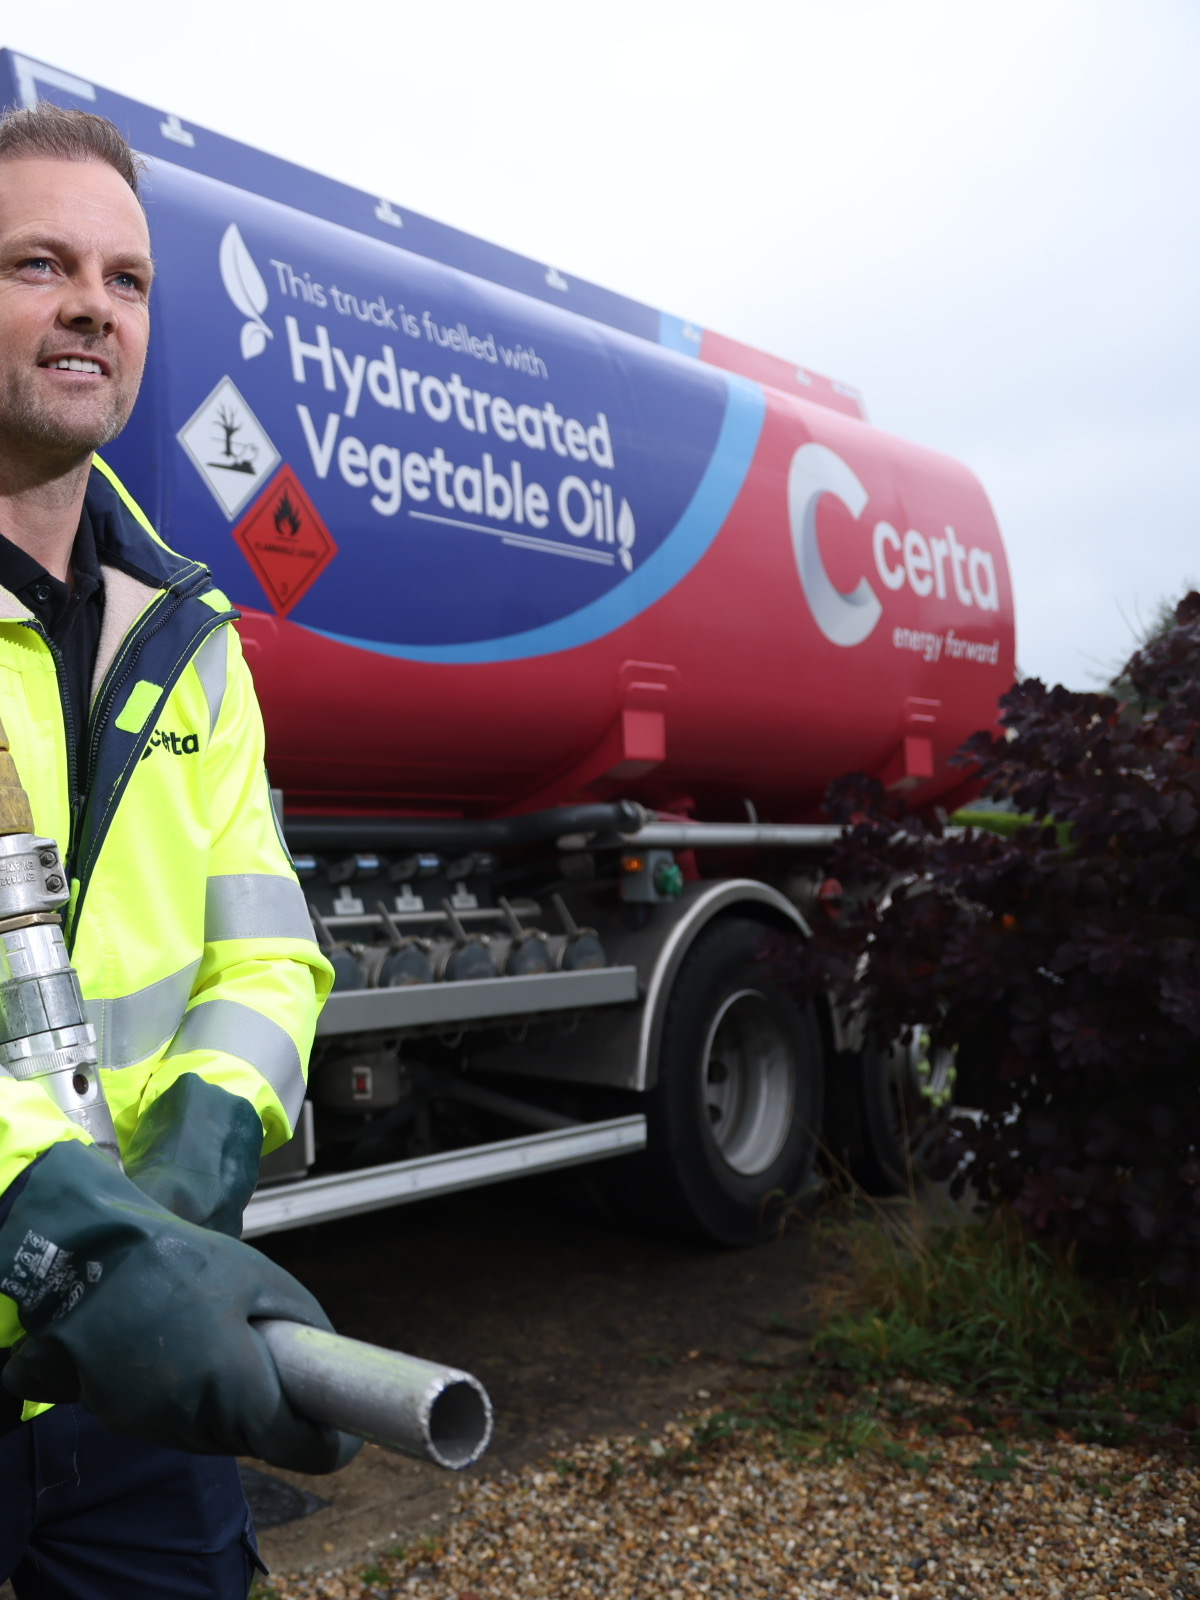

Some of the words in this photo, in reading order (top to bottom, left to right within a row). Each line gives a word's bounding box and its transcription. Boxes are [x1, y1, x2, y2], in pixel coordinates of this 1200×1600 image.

[270, 259, 327, 308] This
[329, 285, 398, 332] truck
[399, 304, 420, 338] is
[421, 310, 498, 364] fuelled
[500, 344, 548, 380] with
[285, 315, 615, 470] Hydrotreated
[296, 404, 550, 528] Vegetable
[558, 475, 615, 544] Oil
[872, 520, 1000, 612] certa
[893, 626, 943, 663] energy
[945, 629, 999, 665] forward
